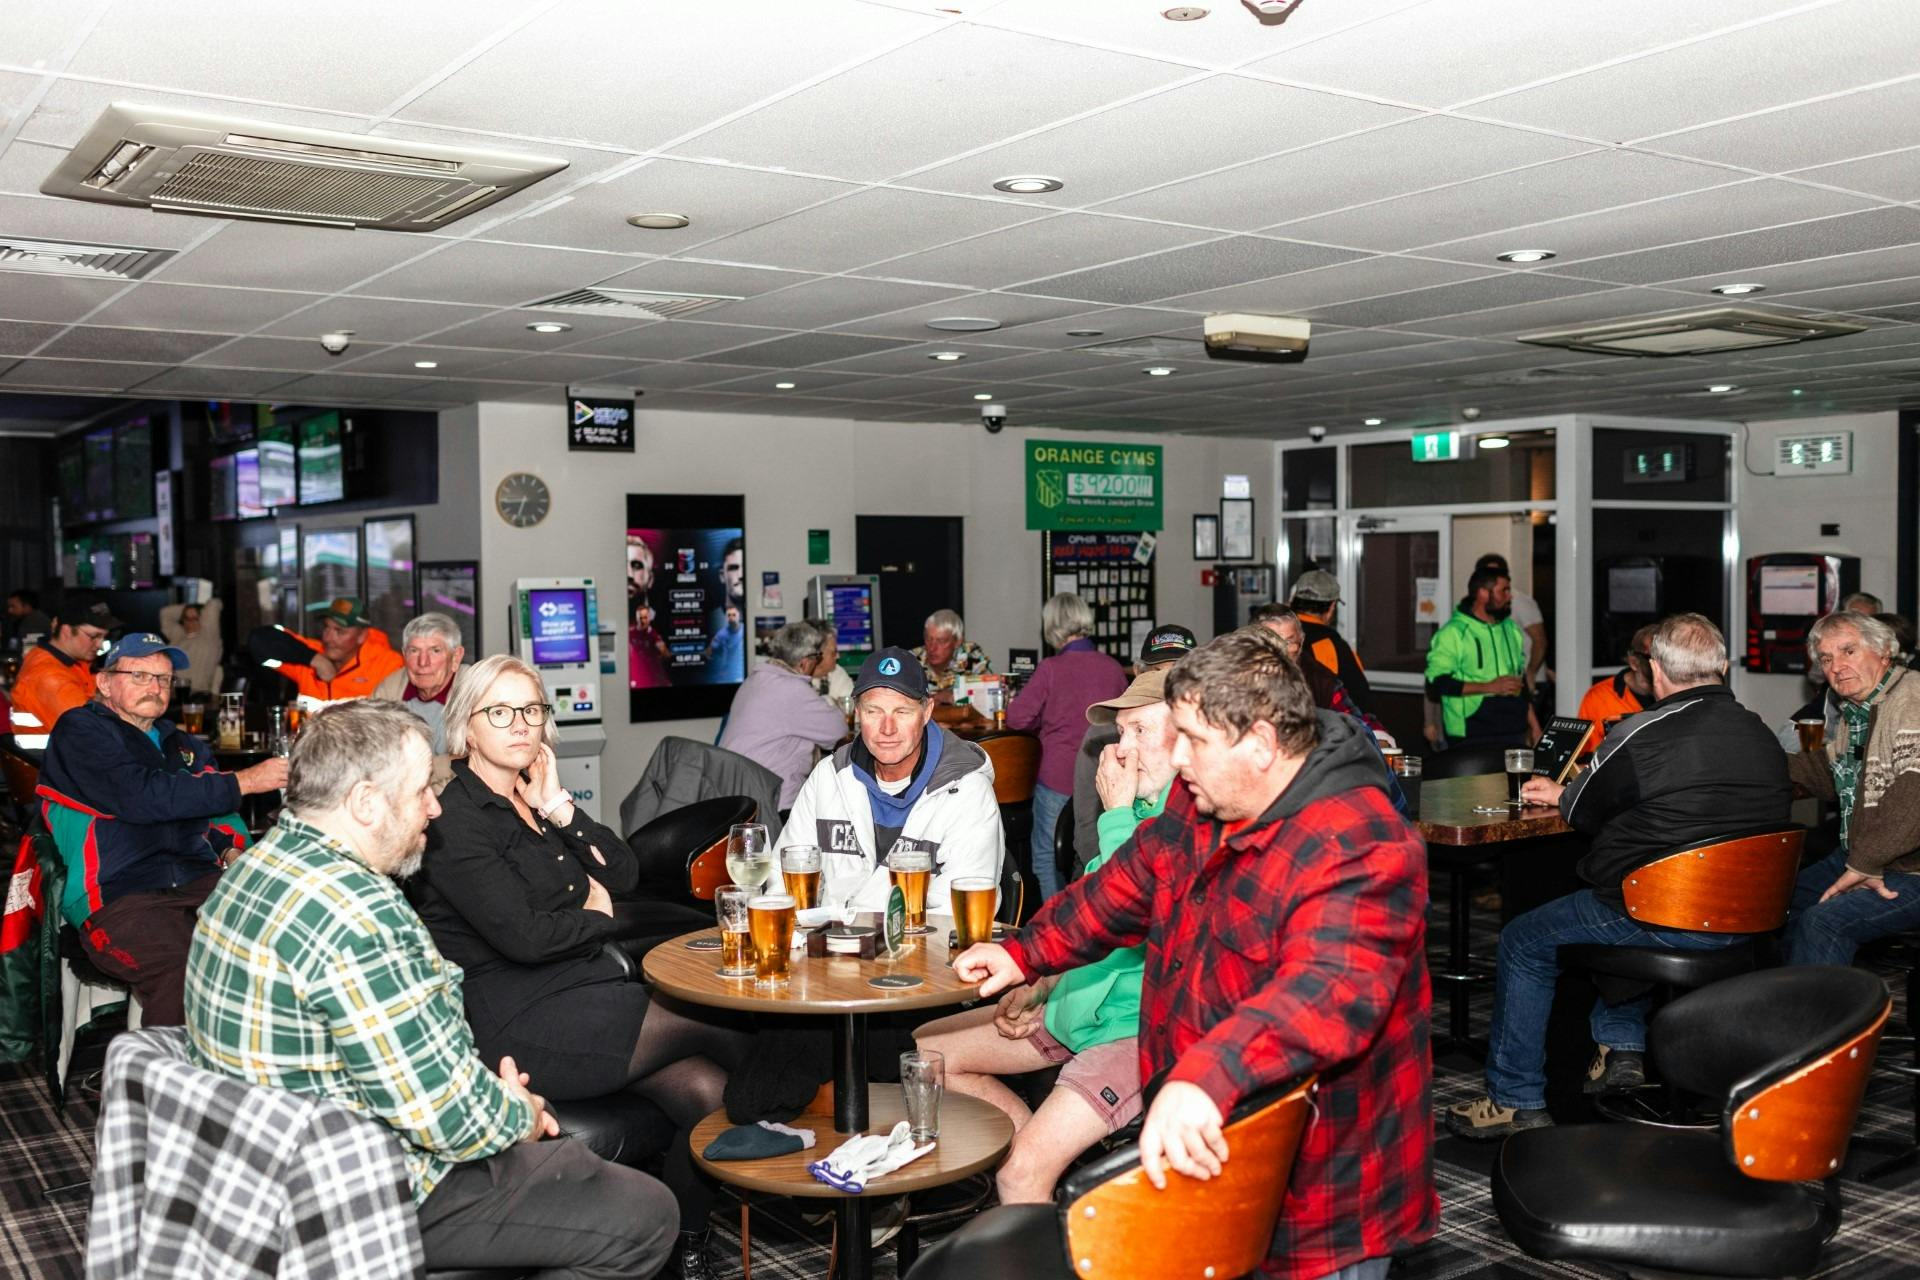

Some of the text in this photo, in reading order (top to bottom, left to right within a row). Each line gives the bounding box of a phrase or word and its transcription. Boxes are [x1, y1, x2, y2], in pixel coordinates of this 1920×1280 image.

[1034, 447, 1156, 466] ORANGE CYMS
[1067, 497, 1155, 508] This Weeks Jackpot Draw
[1068, 535, 1097, 544] OPHIR
[1552, 721, 1587, 730] RESERVED
[570, 790, 593, 800] NO
[830, 823, 859, 852] CH
